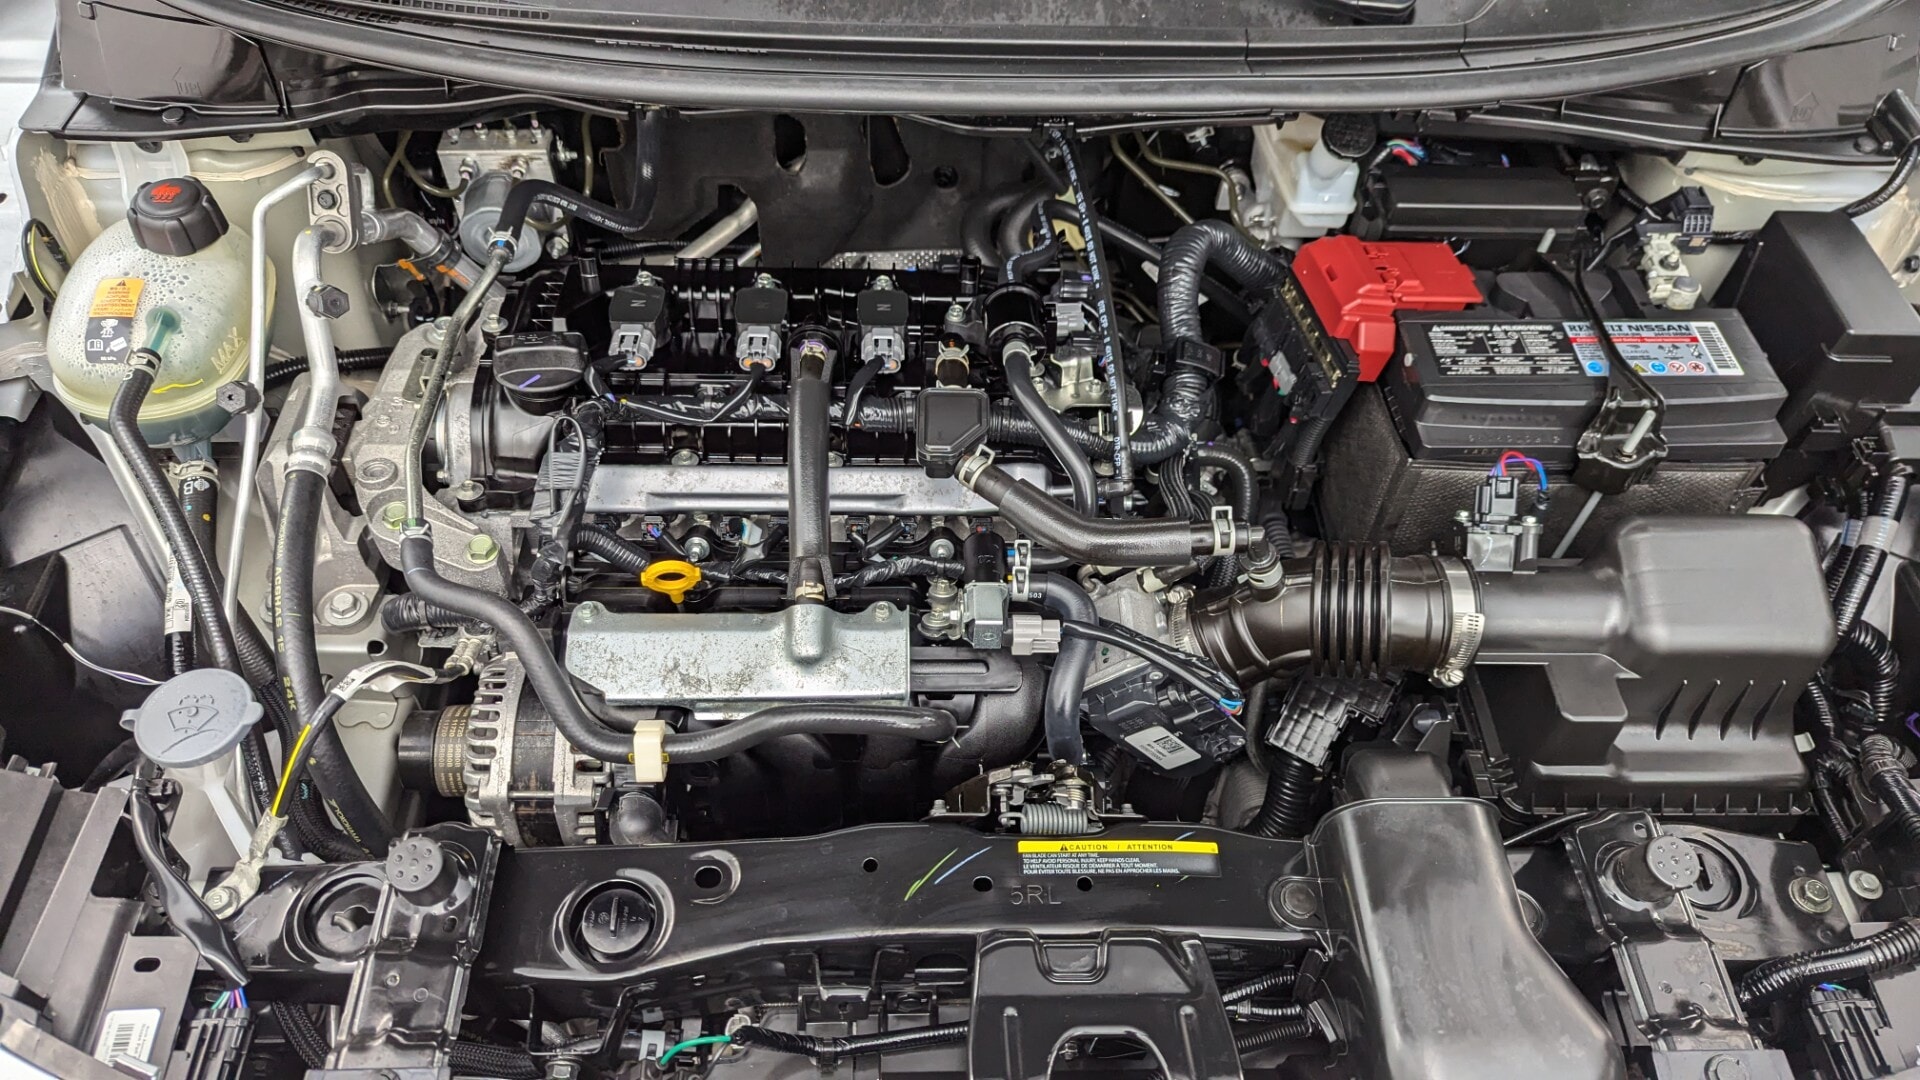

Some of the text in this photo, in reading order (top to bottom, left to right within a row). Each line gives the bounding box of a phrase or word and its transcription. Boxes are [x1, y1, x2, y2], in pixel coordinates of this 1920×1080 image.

[1568, 324, 1691, 332] RENLT NISSAN
[211, 326, 244, 375] MAX
[283, 676, 297, 711] 24K
[1010, 884, 1062, 905] 5RL
